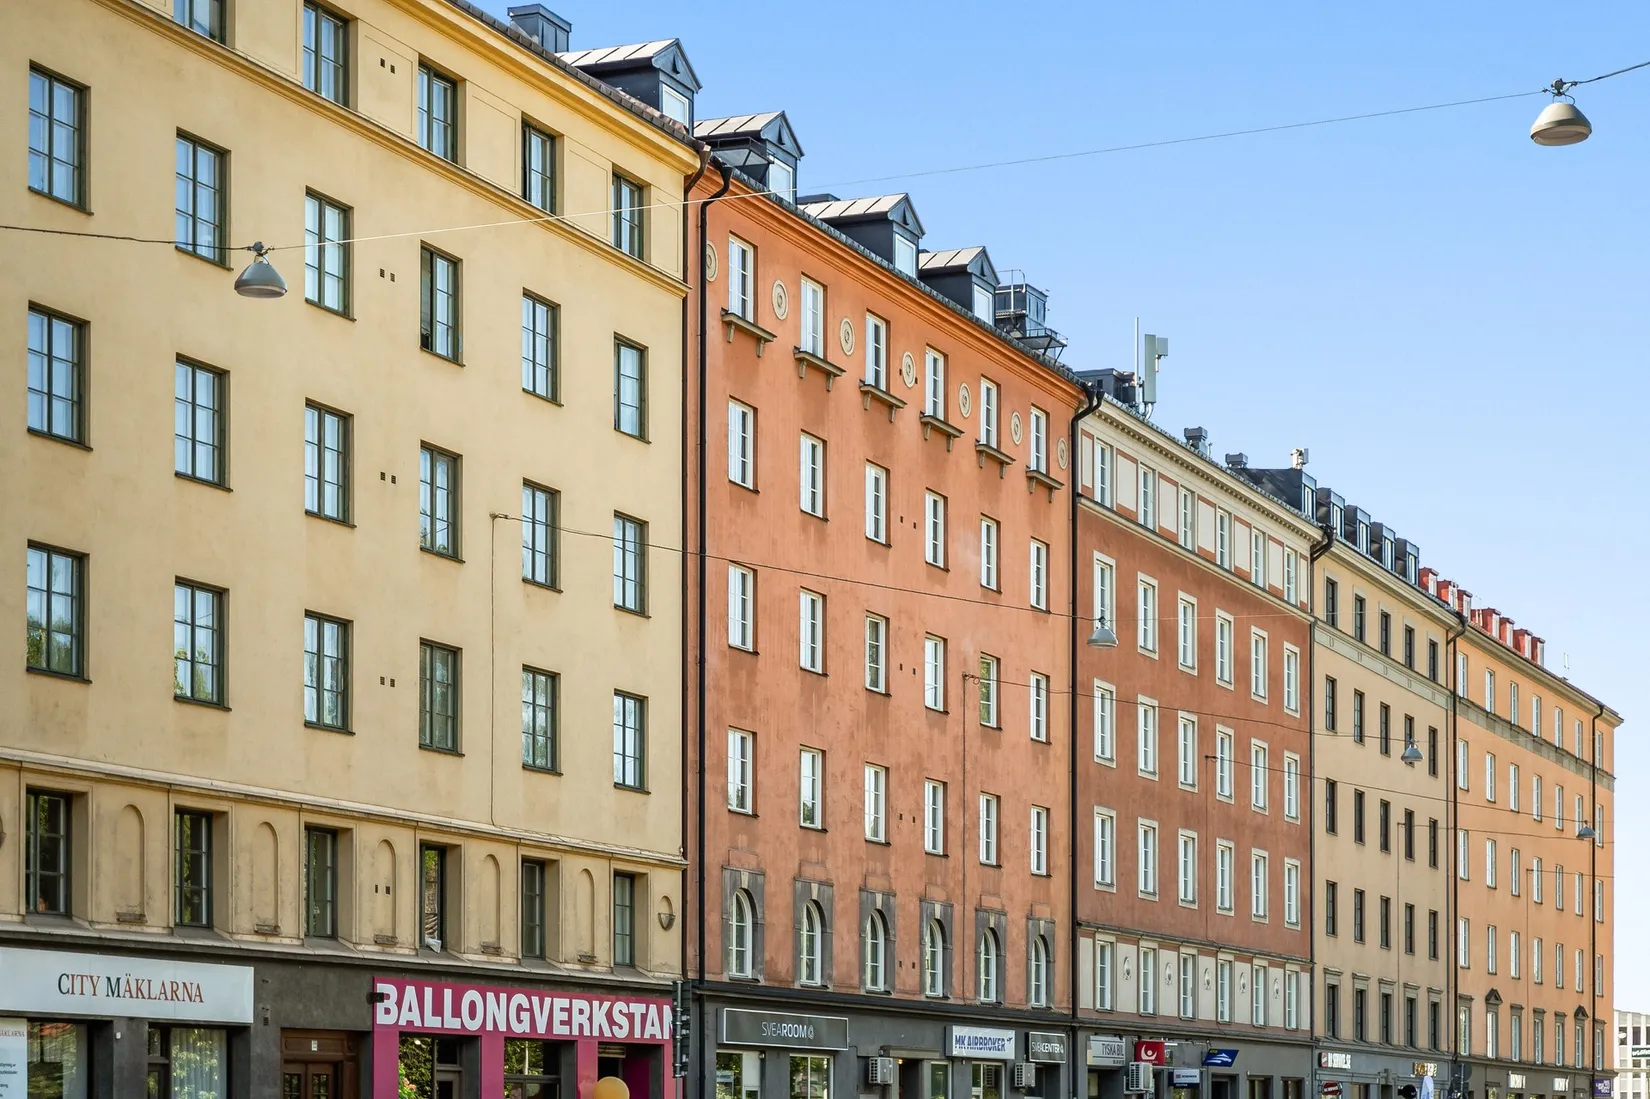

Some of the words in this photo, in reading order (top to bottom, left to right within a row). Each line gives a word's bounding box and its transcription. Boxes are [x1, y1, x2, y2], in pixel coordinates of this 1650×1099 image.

[58, 973, 101, 997] CITY
[105, 973, 204, 1003] MÄKLARNA
[761, 1021, 807, 1038] SVEAROOM
[955, 1034, 966, 1049] MK
[967, 1035, 1006, 1052] AIRBROKER
